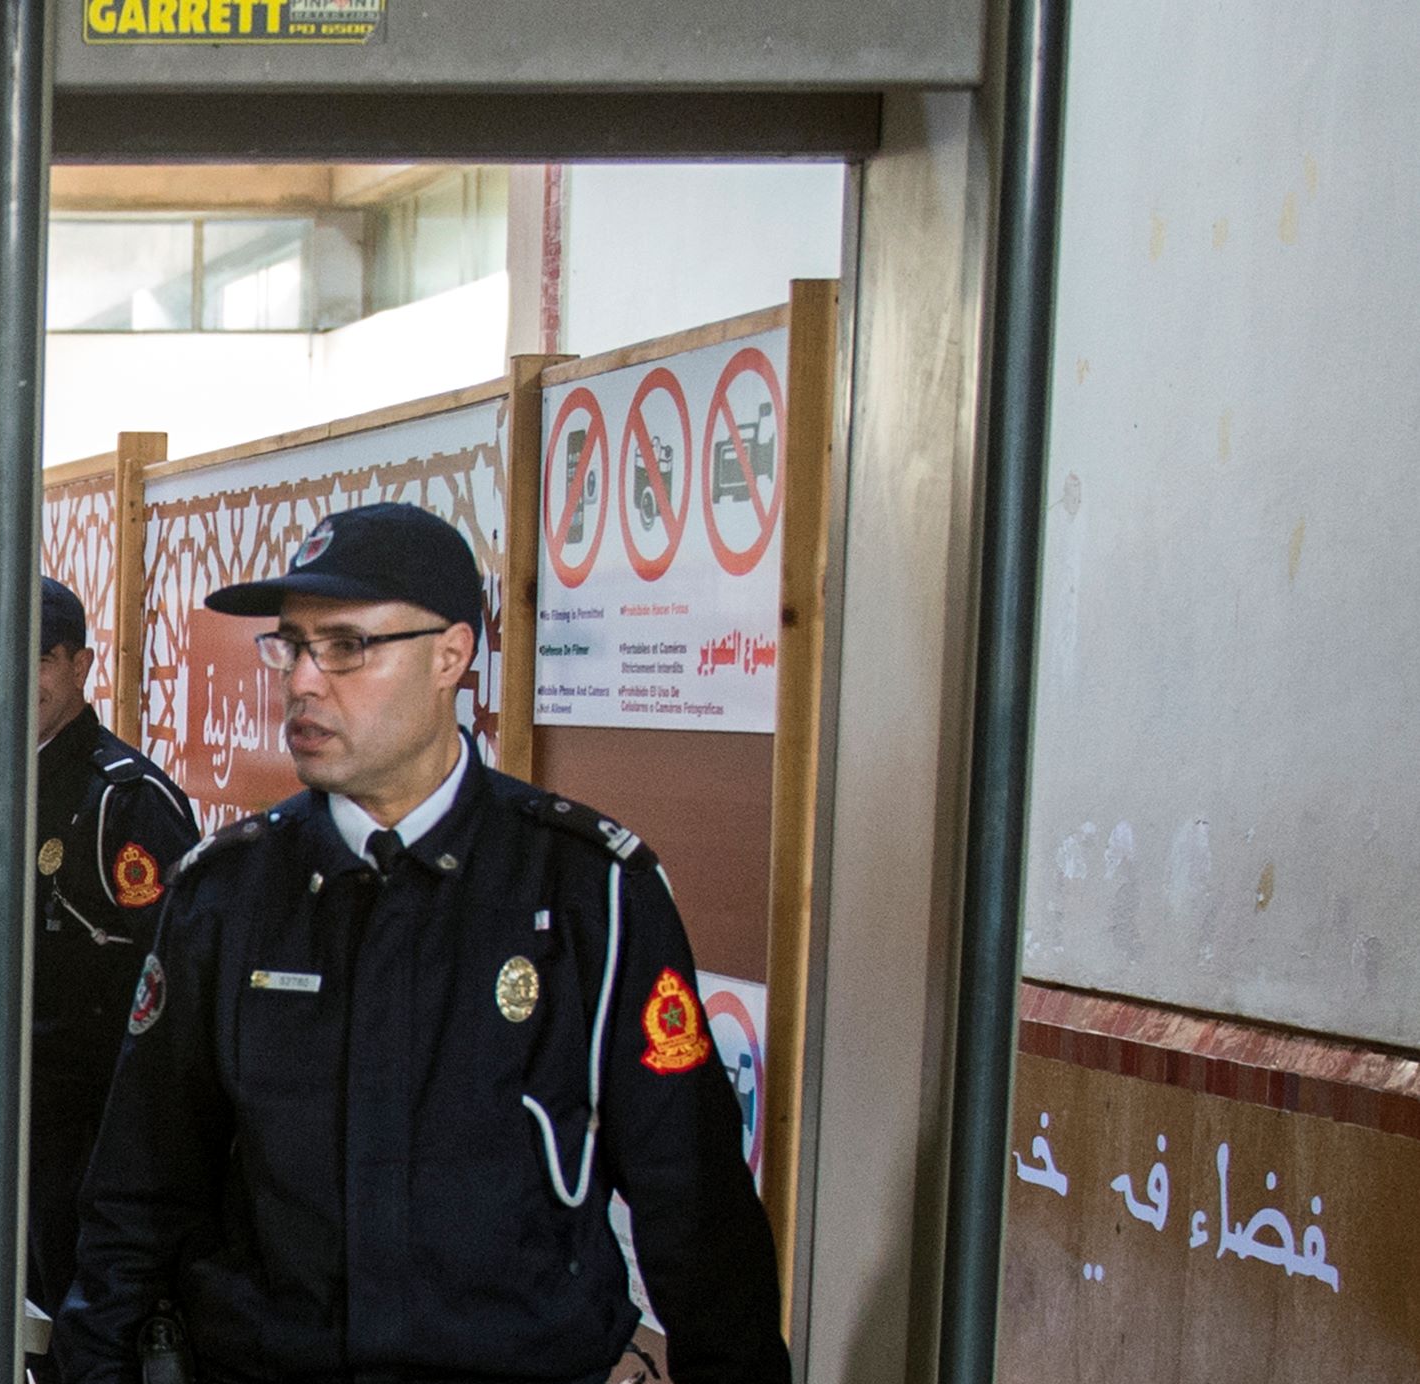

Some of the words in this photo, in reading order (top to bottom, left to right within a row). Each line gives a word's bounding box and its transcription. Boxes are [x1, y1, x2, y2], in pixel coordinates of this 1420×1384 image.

[88, 0, 287, 34] GARRETT
[203, 663, 269, 789] المغربية
[1188, 1142, 1340, 1293] فضاء
